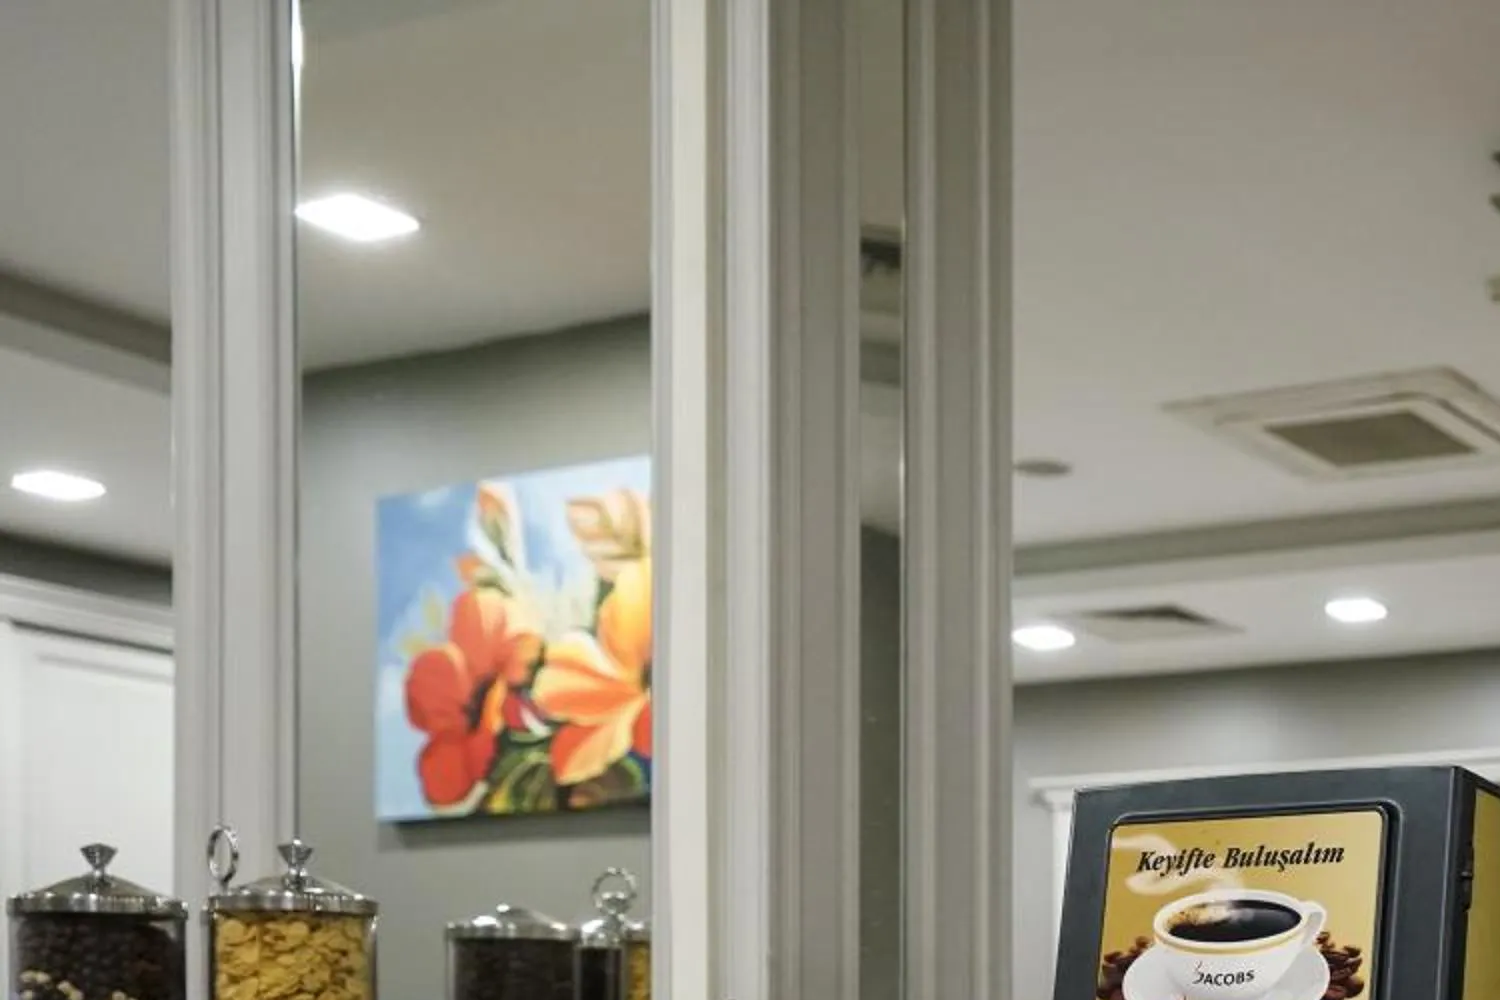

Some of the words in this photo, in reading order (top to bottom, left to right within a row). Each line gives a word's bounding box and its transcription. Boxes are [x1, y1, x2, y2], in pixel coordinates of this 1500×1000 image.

[1136, 847, 1216, 877] Keyifte
[1223, 841, 1345, 872] Buluşalım
[1192, 969, 1256, 986] JACOBS
